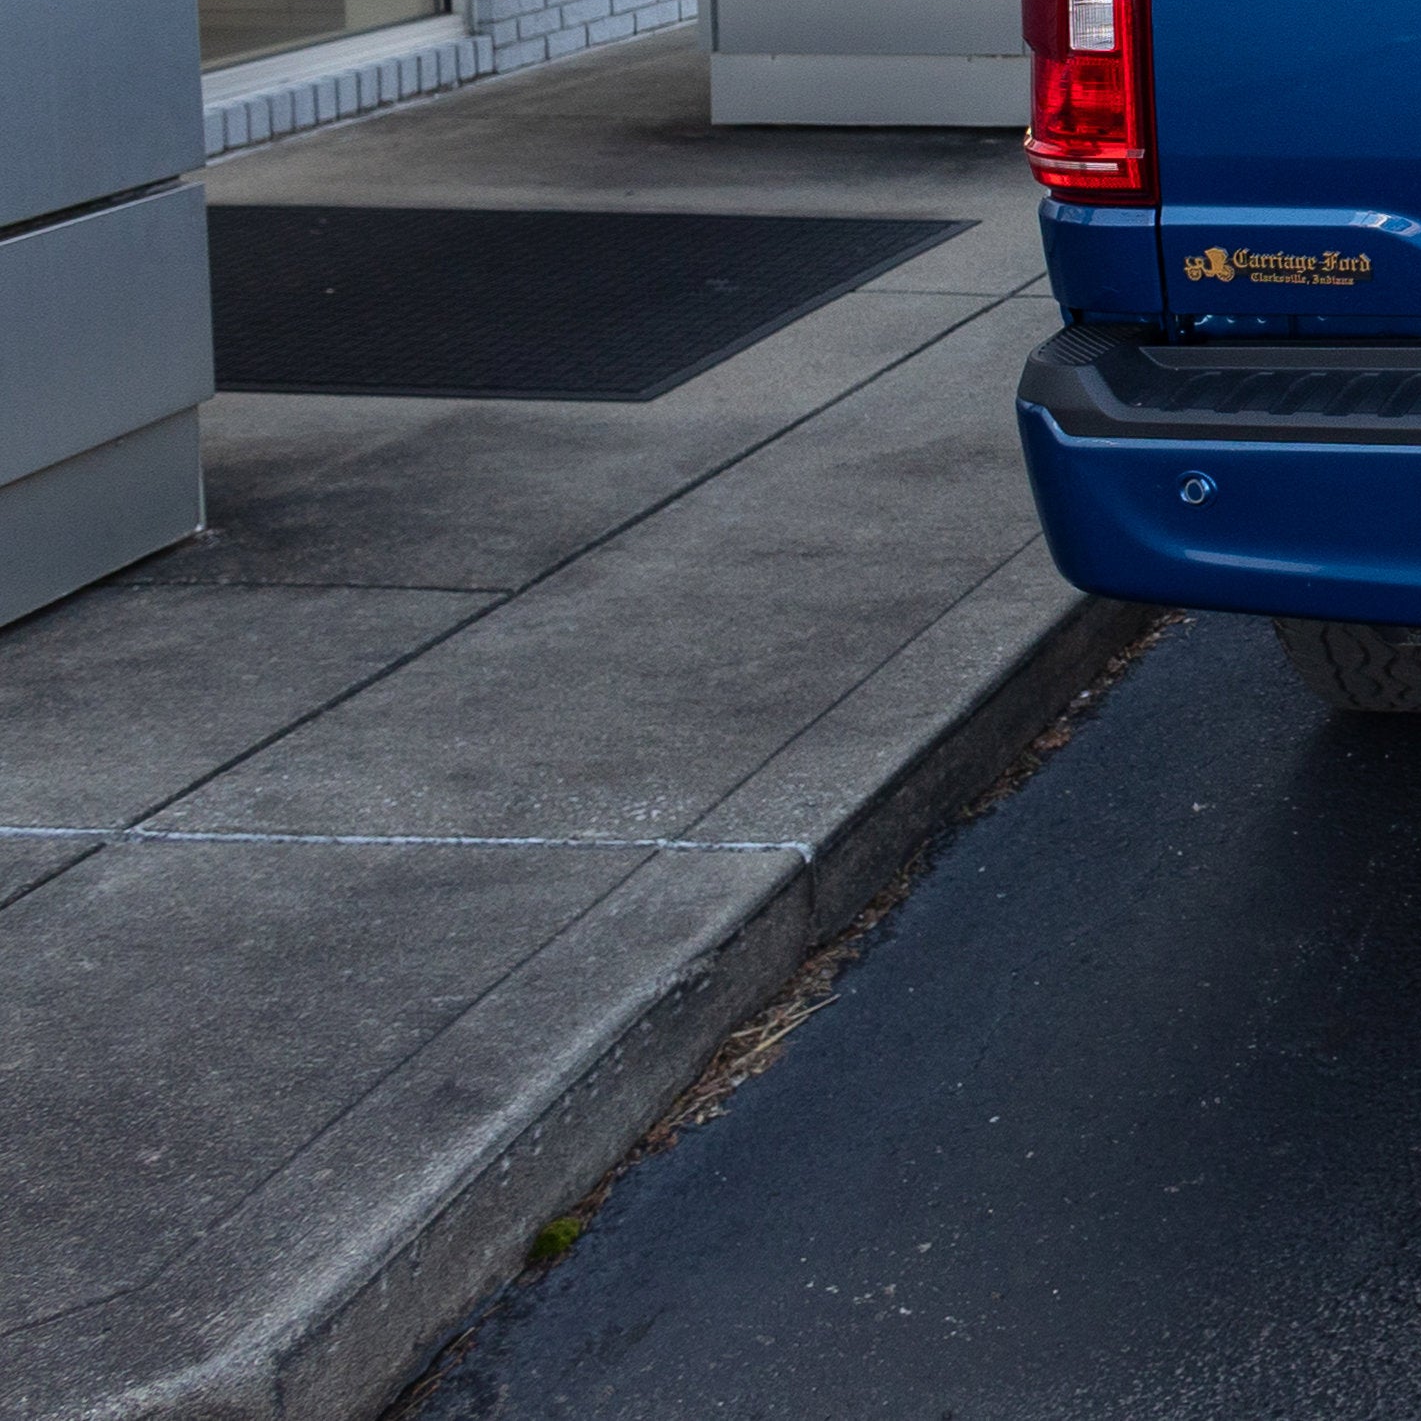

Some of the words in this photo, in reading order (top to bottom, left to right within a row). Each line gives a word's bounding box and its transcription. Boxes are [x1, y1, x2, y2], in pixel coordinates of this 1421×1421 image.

[1232, 247, 1317, 273] Carriage
[1321, 250, 1372, 272] Ford
[1312, 275, 1355, 286] Indiana
